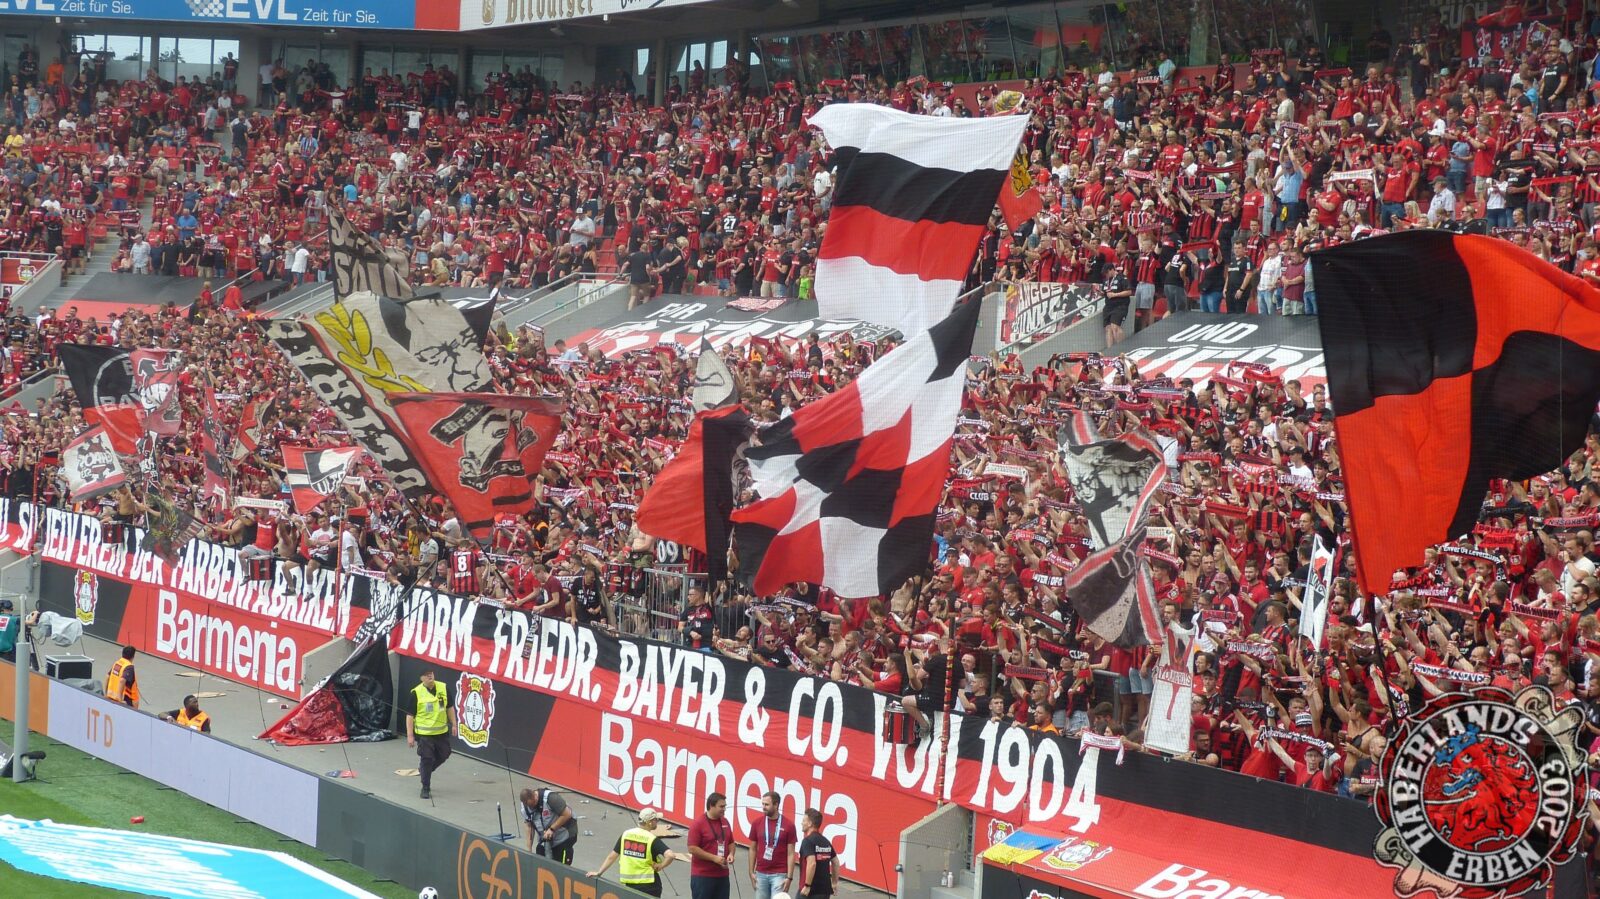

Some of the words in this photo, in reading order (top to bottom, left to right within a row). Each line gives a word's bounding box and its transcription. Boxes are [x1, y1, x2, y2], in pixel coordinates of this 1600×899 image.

[60, 0, 86, 12] Zeit
[89, 0, 108, 12] für
[111, 1, 135, 14] Sie.
[226, 0, 298, 20] EVL
[303, 8, 328, 21] Zeit
[333, 9, 351, 23] für
[355, 10, 379, 24] Sie.
[723, 217, 737, 230] 27
[1167, 321, 1259, 344] UND
[970, 492, 989, 501] CLUB
[656, 538, 680, 564] 09
[457, 555, 468, 572] 8
[156, 588, 297, 693] Barmenia
[399, 588, 480, 668] VORM.
[611, 640, 726, 737] BAYER
[738, 667, 770, 748] &
[787, 677, 849, 767] CO.
[969, 721, 1101, 833] 1904
[598, 711, 858, 870] Barmenia
